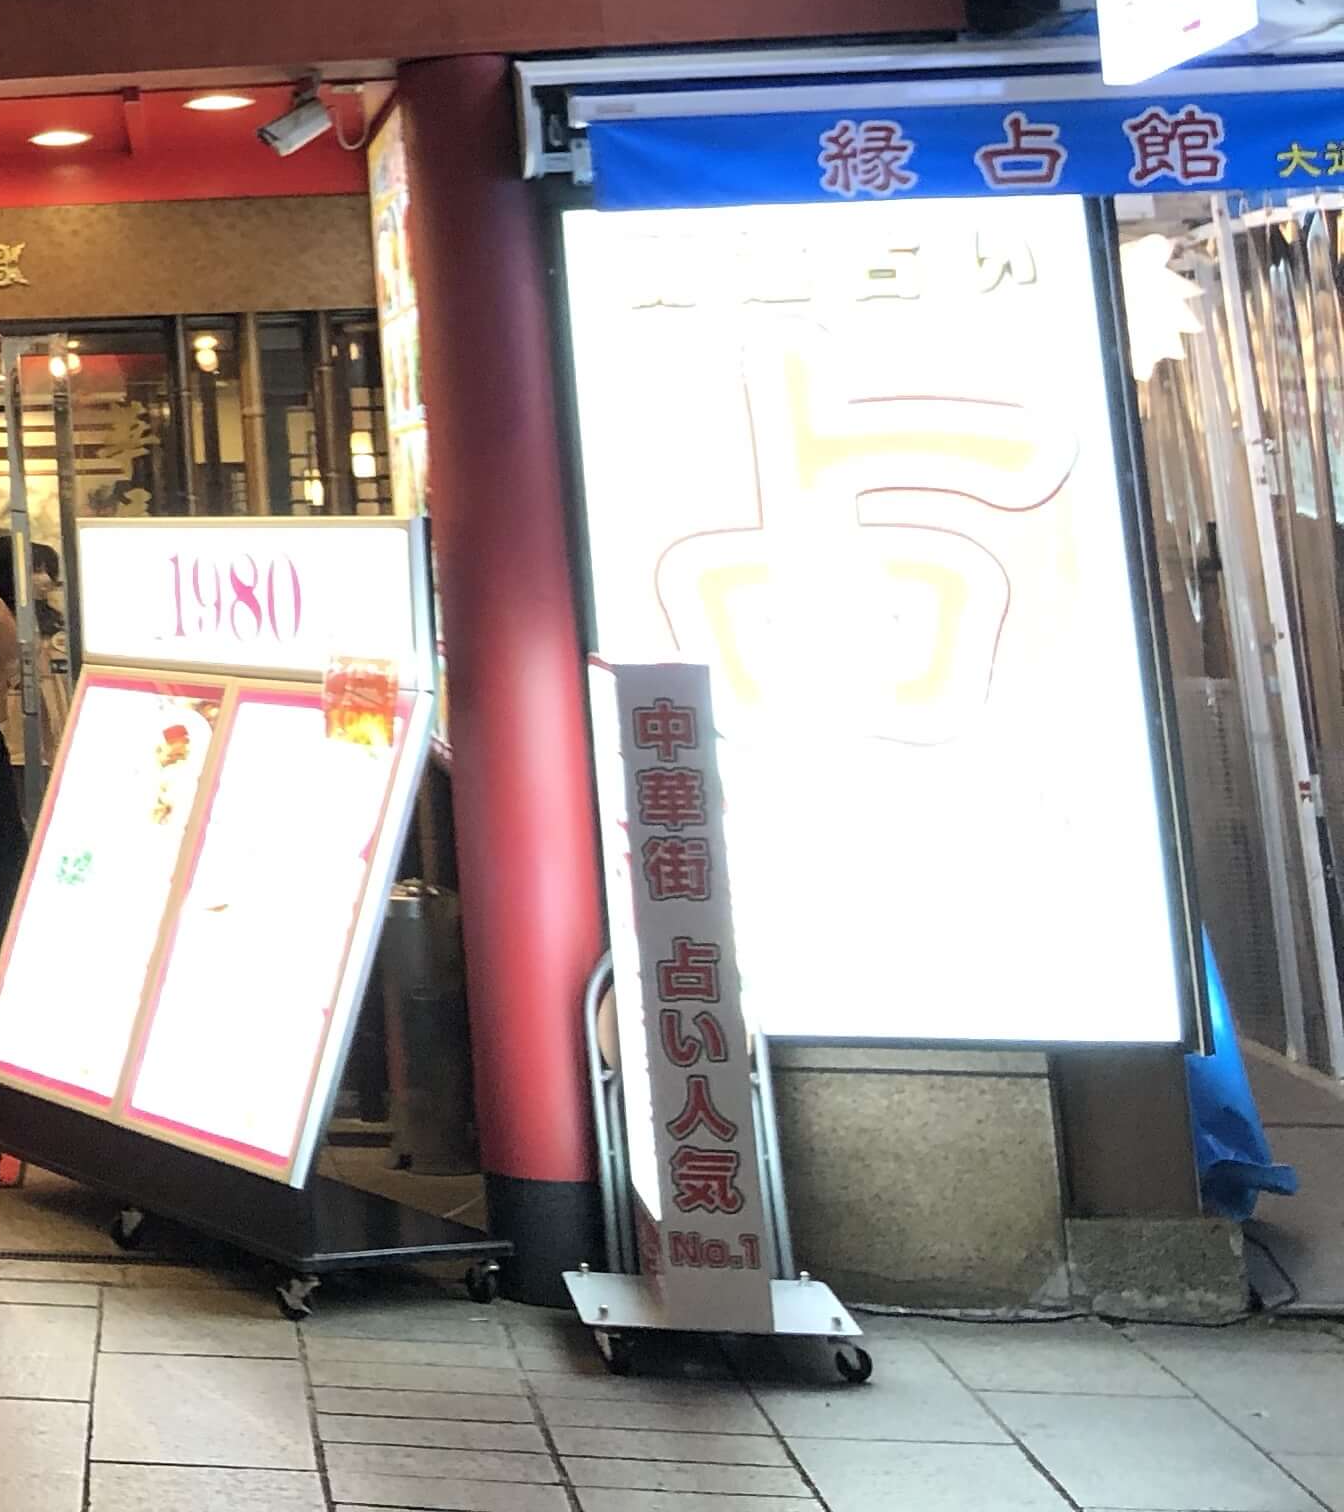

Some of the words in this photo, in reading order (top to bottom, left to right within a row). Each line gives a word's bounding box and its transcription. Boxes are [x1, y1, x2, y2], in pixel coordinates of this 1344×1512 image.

[819, 103, 1227, 197] 縁占館
[169, 553, 302, 641] 1980
[632, 697, 712, 902] 中華街
[656, 937, 744, 1215] 占い人気
[669, 1231, 761, 1270] No.1
